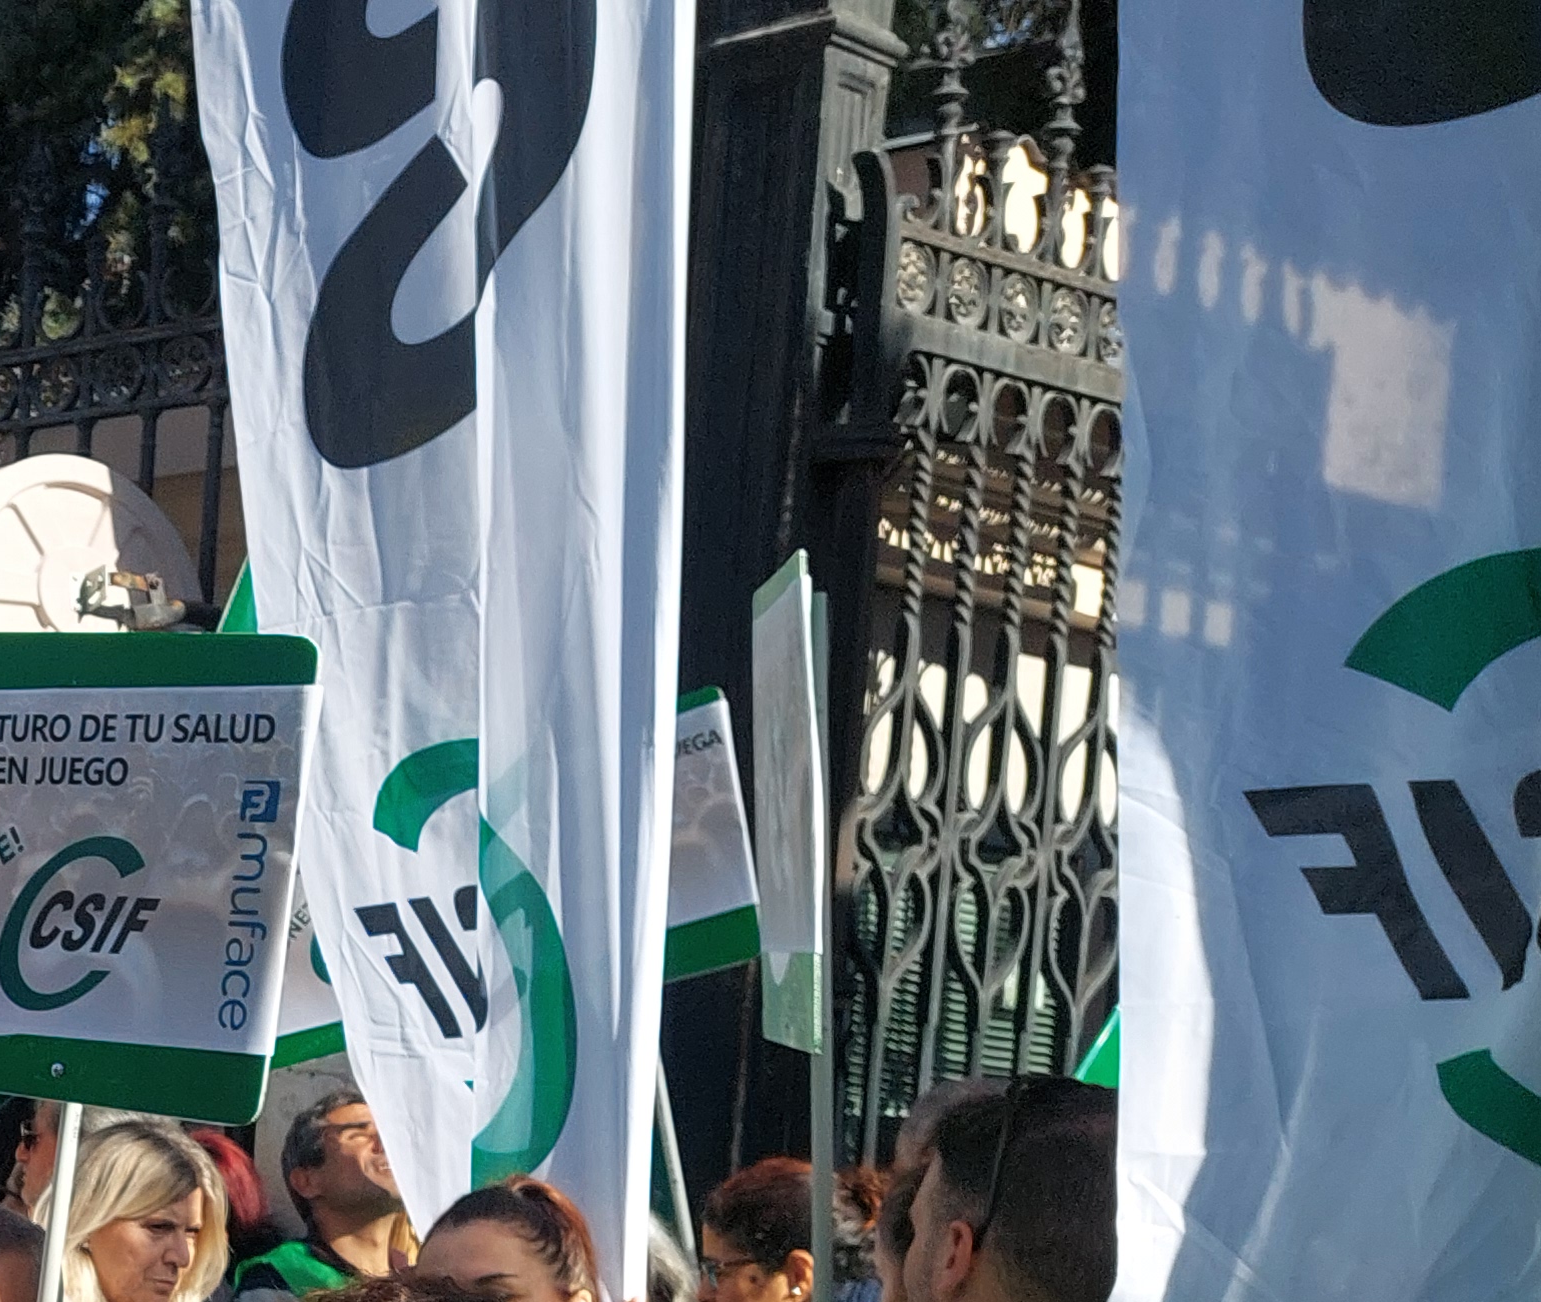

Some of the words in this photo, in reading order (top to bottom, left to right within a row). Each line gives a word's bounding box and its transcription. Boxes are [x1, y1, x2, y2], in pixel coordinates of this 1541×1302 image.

[79, 714, 116, 742] DE
[125, 714, 164, 742] TU
[172, 714, 275, 743] SALUD
[35, 757, 128, 786] JUEGO
[28, 890, 161, 954] CSIF
[218, 832, 270, 1031] muface
